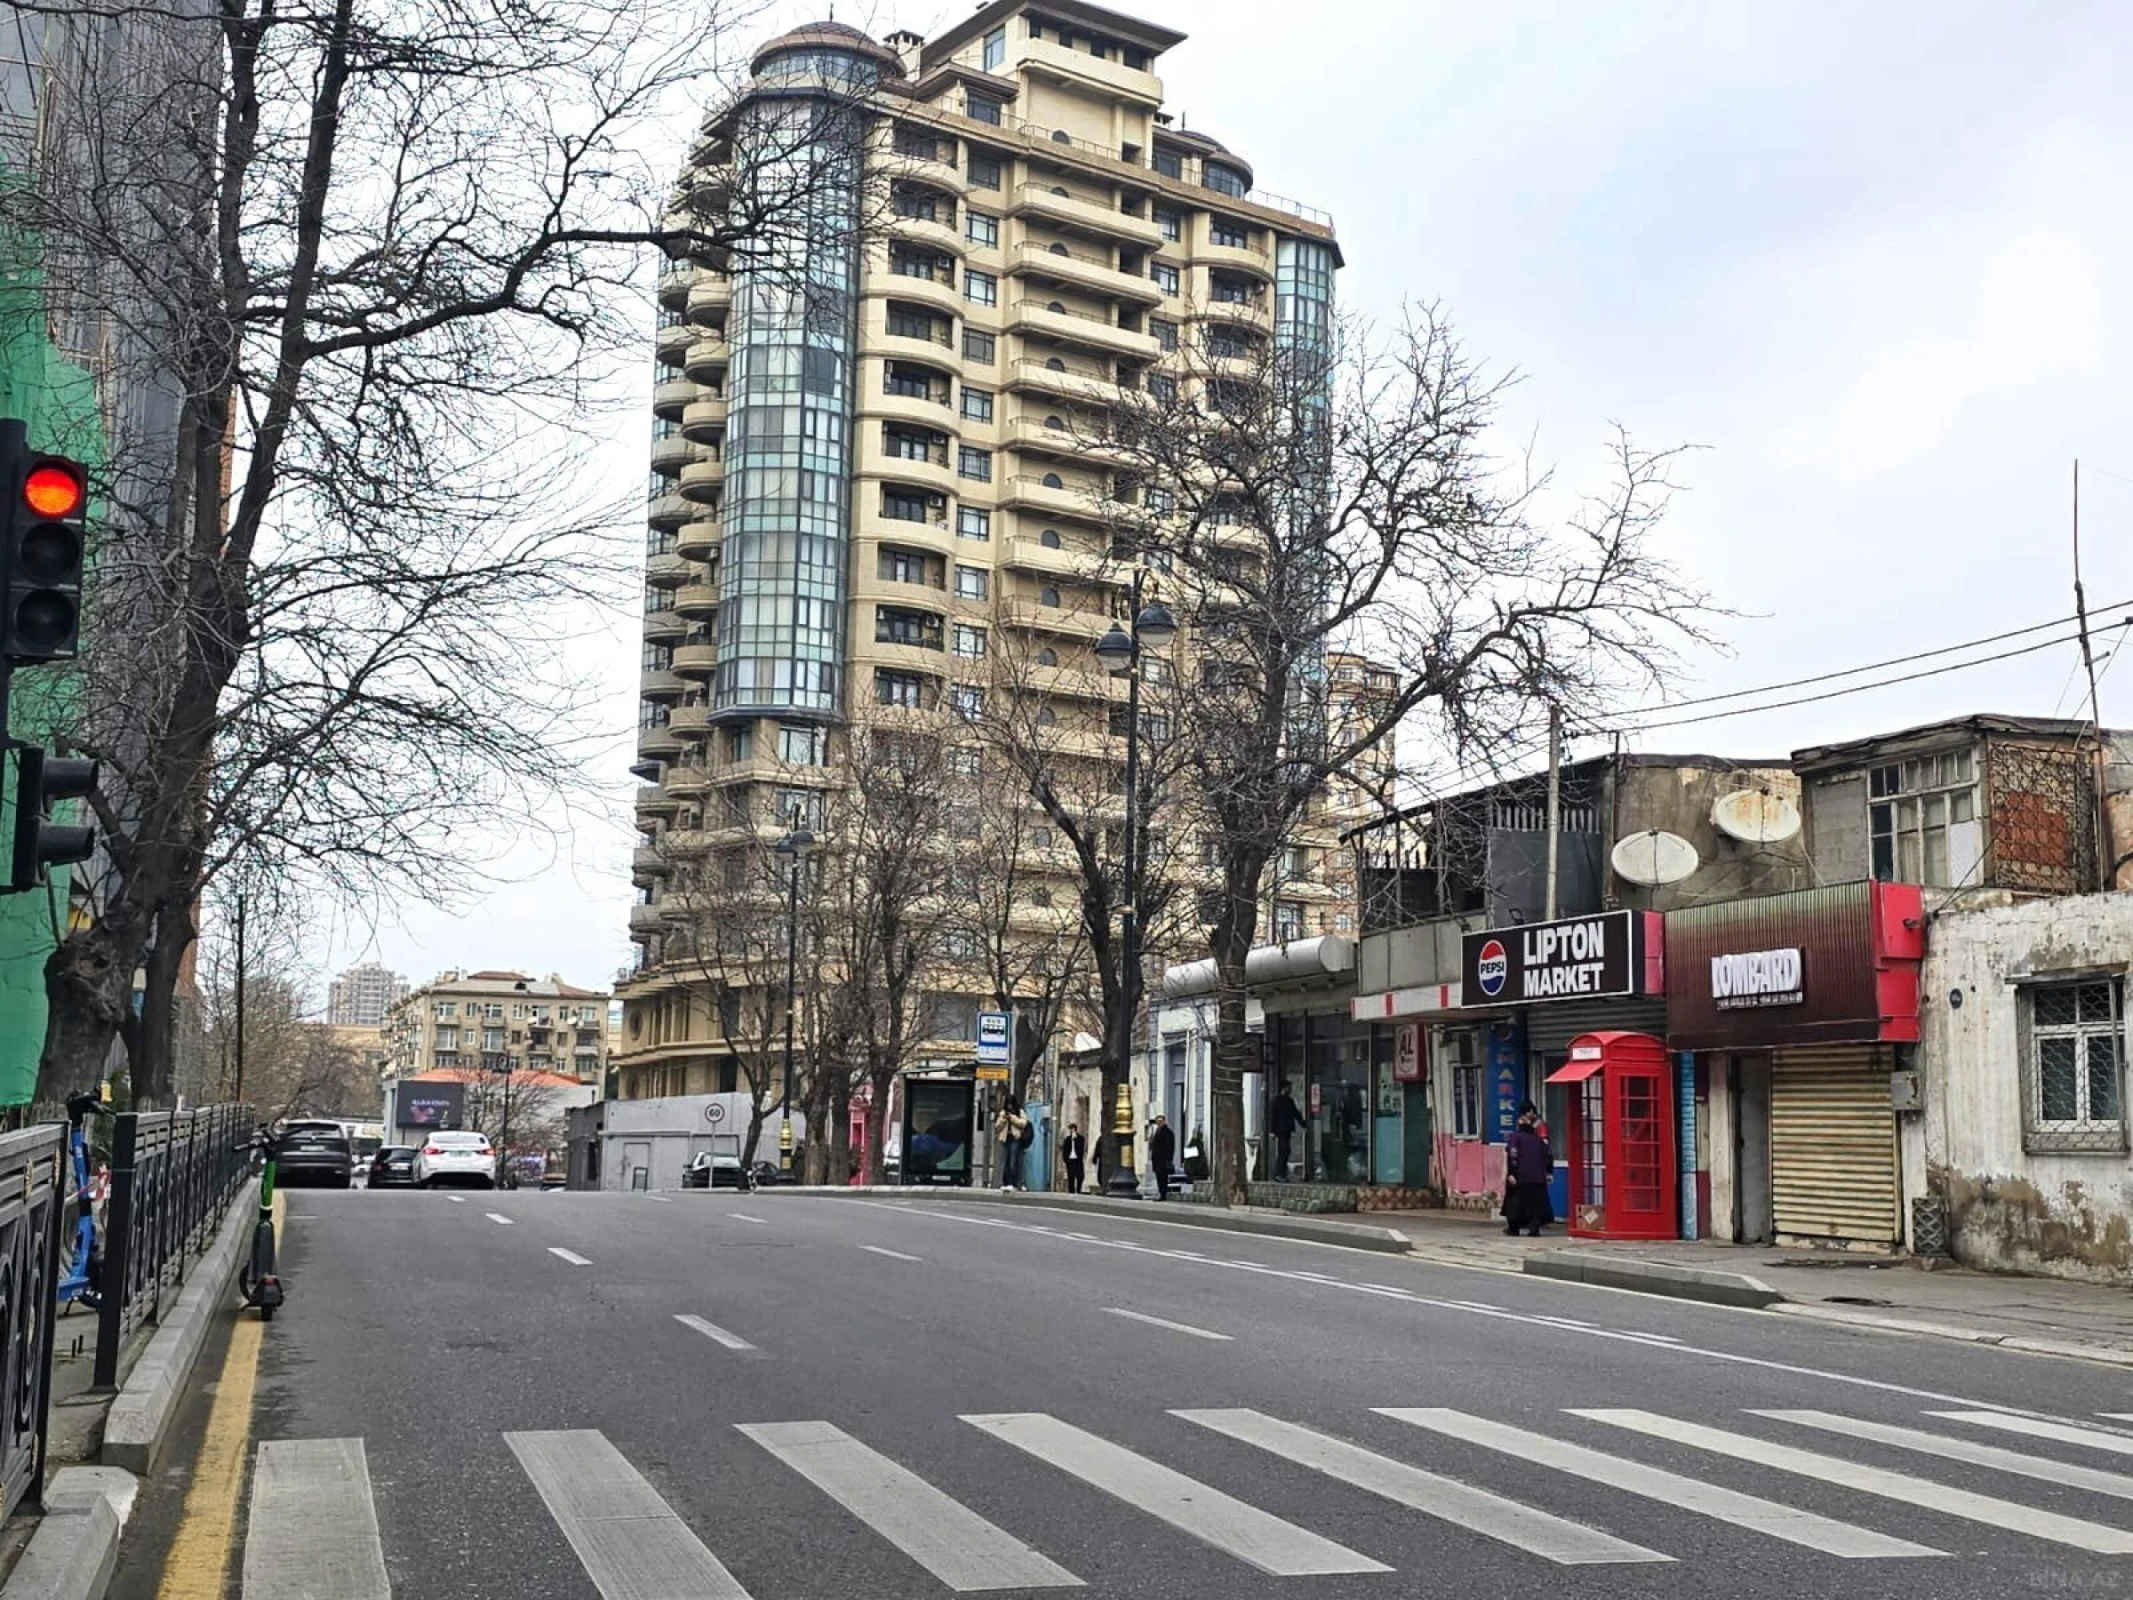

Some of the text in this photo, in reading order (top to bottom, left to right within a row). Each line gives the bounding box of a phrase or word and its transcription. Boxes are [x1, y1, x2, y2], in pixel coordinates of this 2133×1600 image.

[1523, 920, 1605, 966] LIPTON
[1480, 961, 1505, 974] PEPSI
[1523, 962, 1605, 998] MARKET
